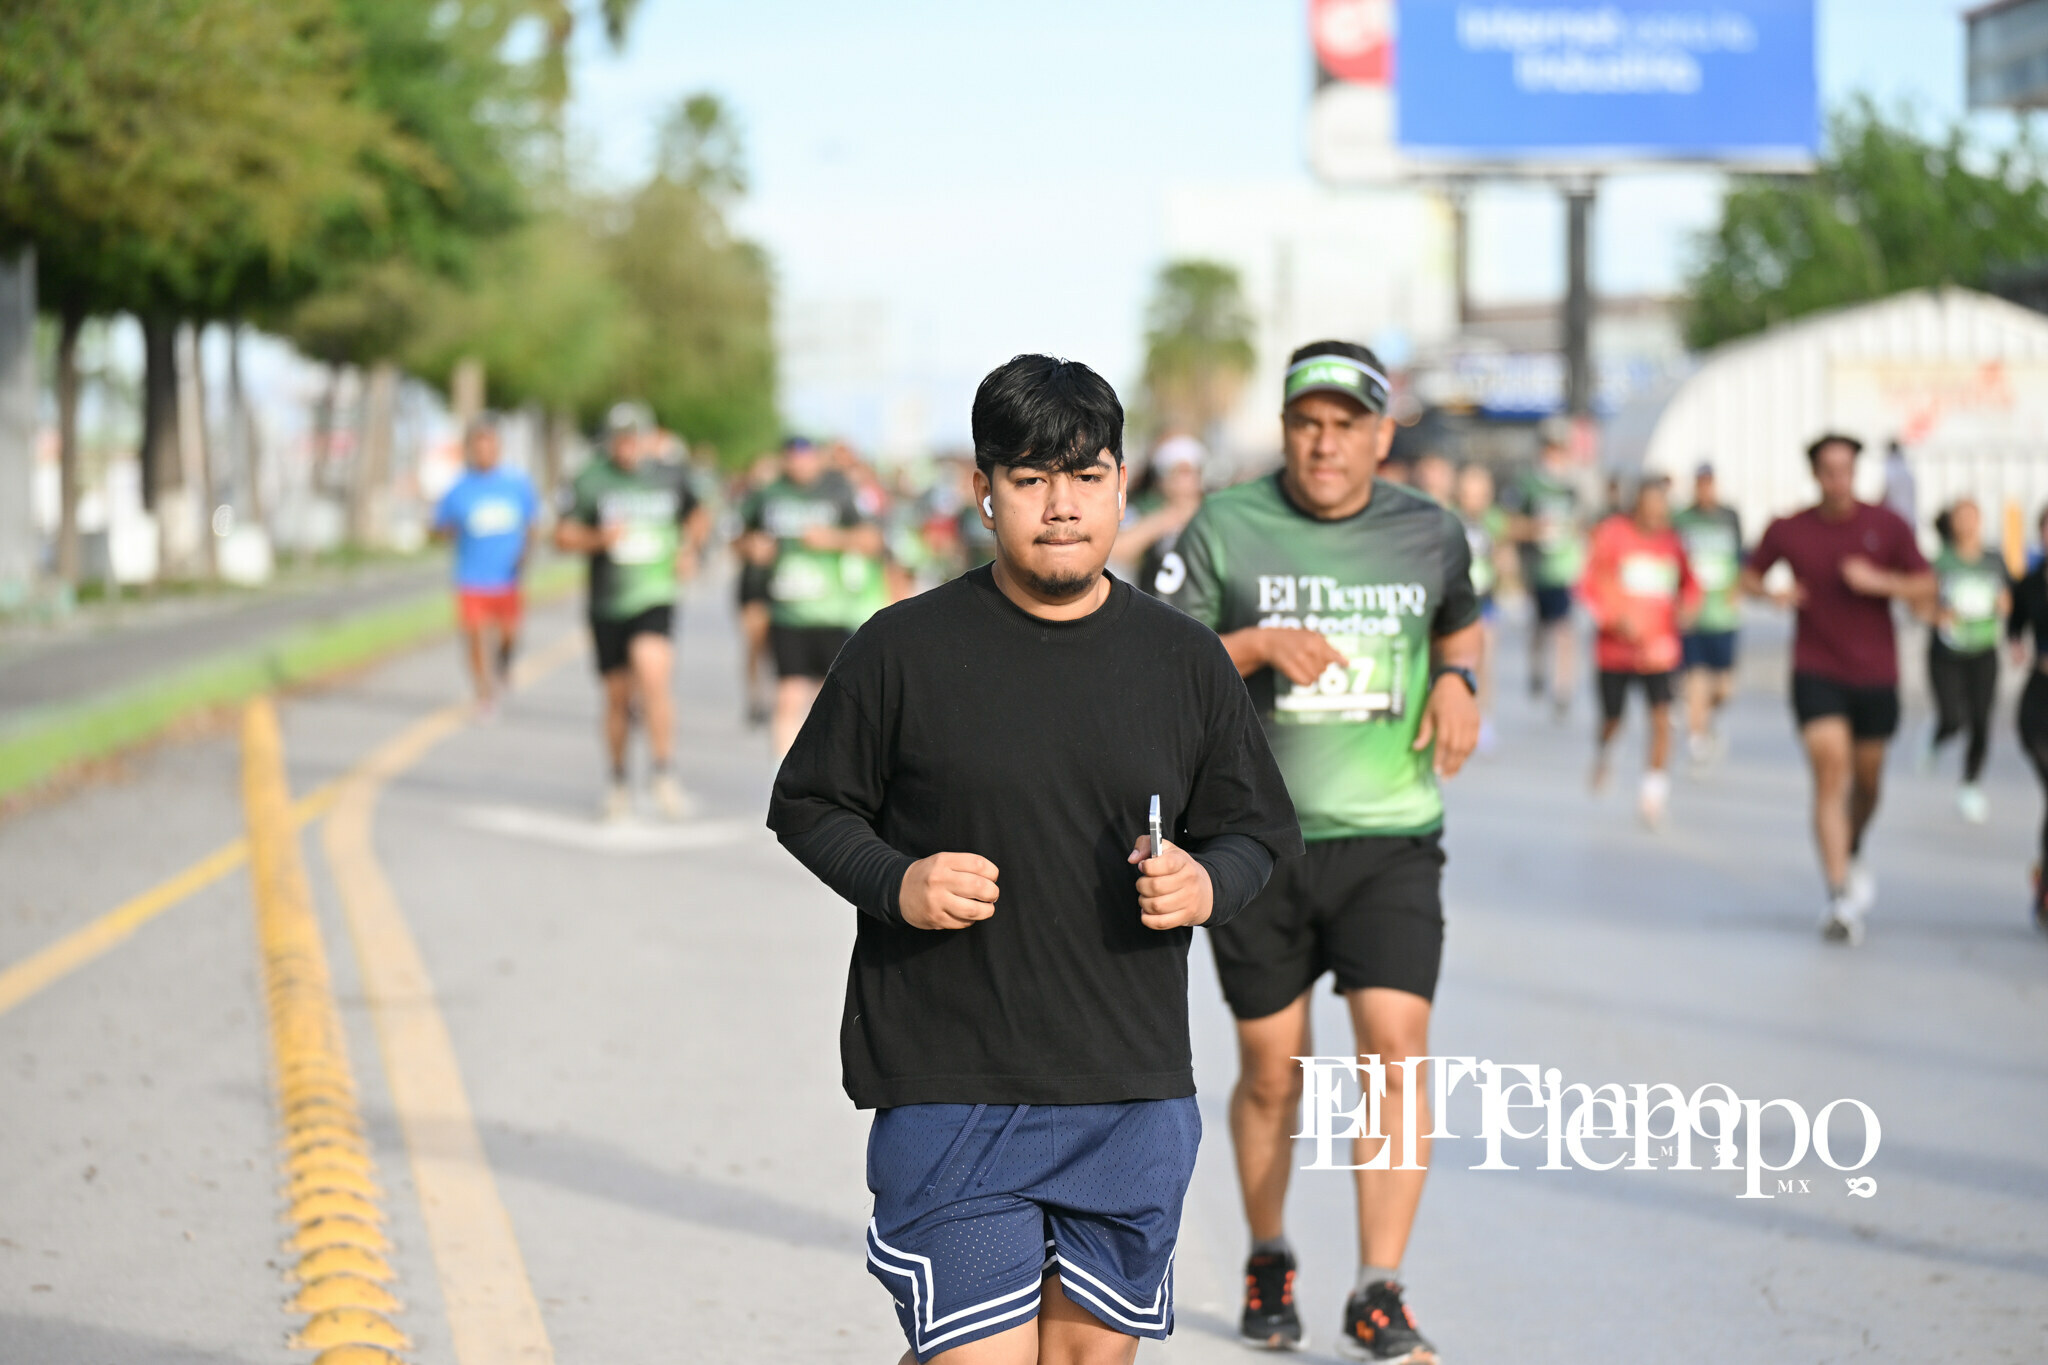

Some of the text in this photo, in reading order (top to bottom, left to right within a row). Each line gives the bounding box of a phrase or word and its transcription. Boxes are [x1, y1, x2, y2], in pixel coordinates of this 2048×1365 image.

[1258, 575, 1426, 617] El Tiempo
[1303, 613, 1401, 636] todos
[1291, 656, 1375, 694] 67
